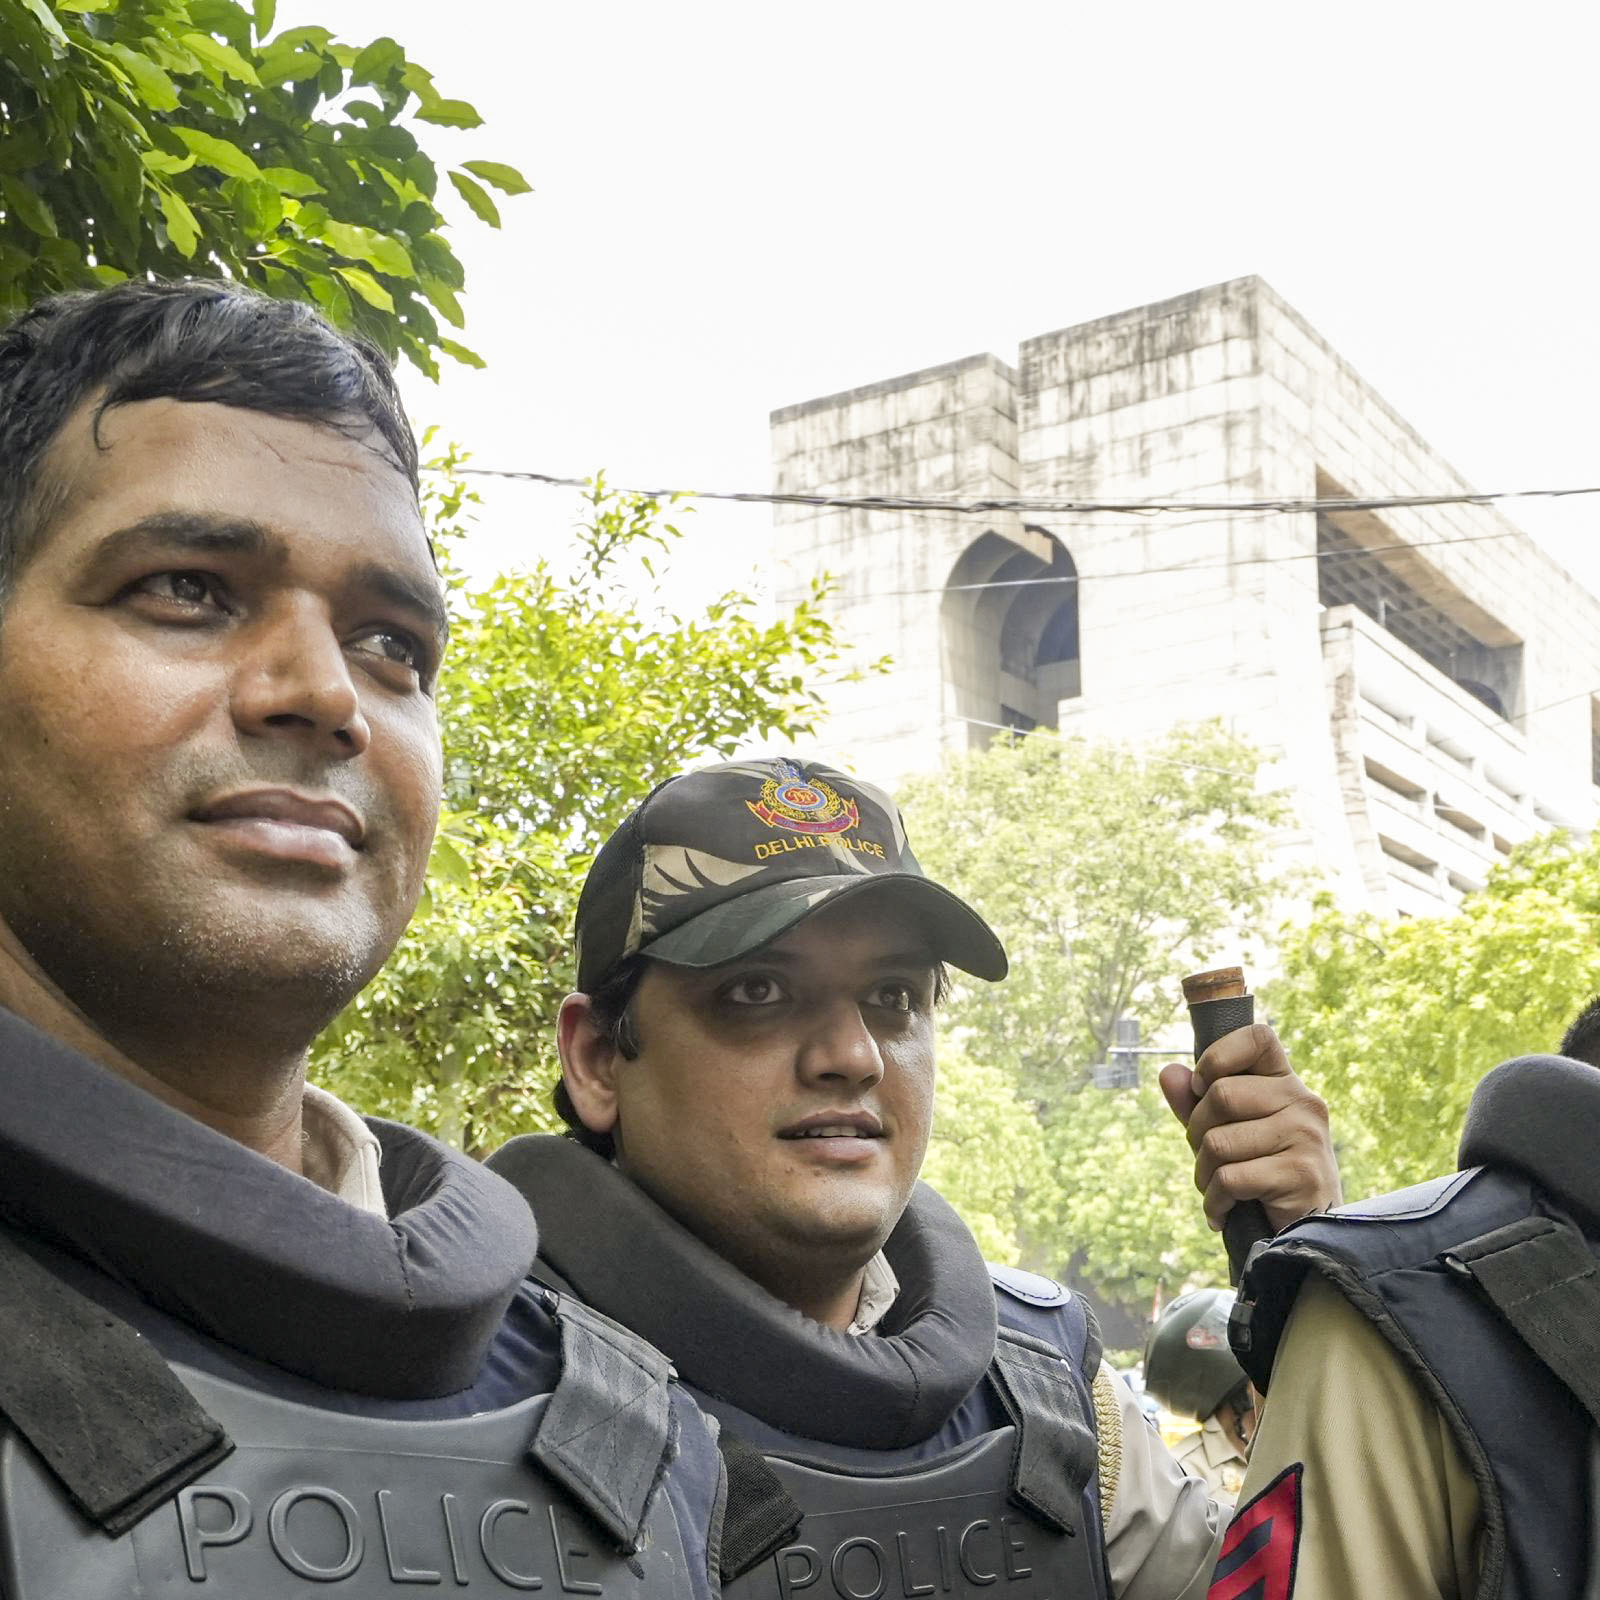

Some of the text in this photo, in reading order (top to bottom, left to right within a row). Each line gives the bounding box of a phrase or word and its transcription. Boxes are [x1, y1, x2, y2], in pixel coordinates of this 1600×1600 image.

[754, 836, 886, 859] DELHI POLICE
[177, 1482, 603, 1595] POLICE
